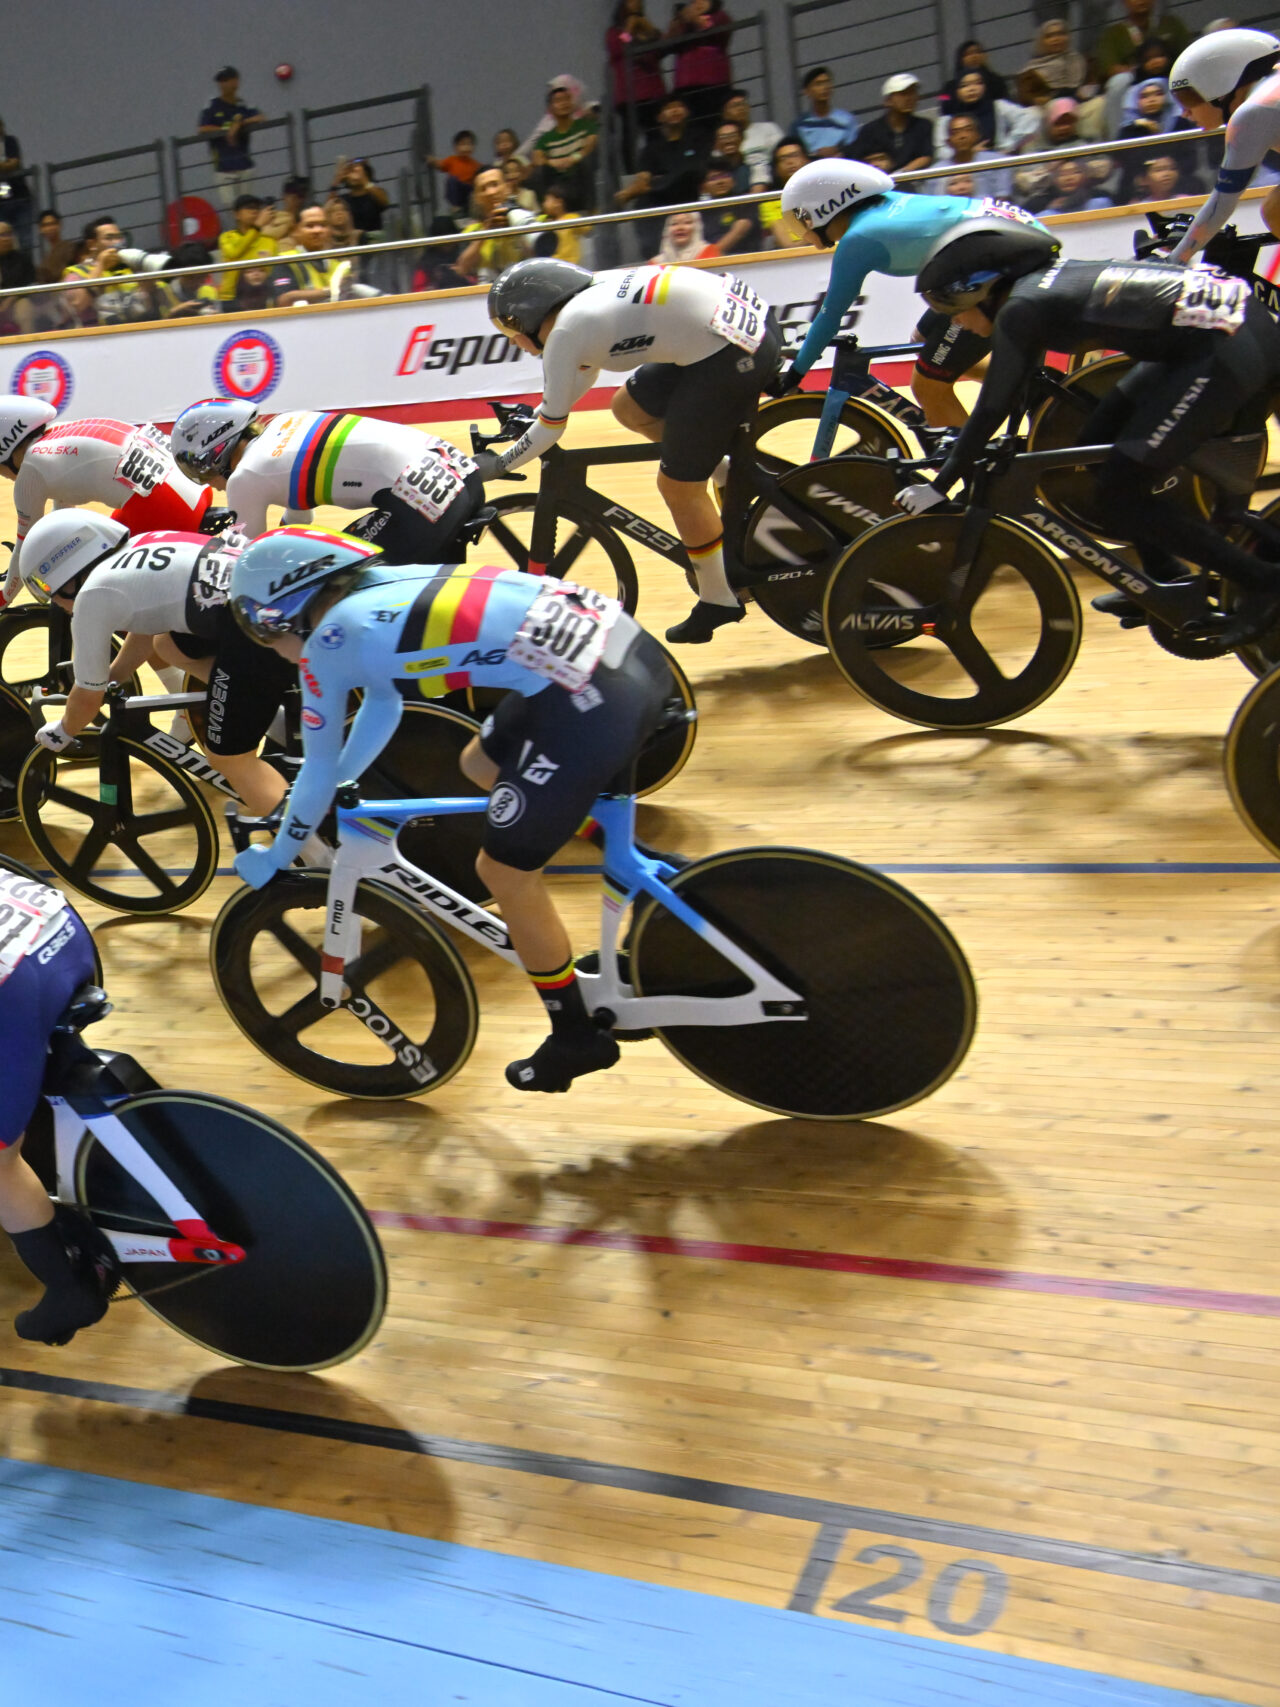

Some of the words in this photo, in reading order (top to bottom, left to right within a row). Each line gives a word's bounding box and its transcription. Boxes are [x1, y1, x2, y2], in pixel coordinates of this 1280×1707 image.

[722, 298, 758, 337] 318
[609, 334, 655, 352] KTM
[931, 343, 951, 365] HONG
[1147, 377, 1210, 448] MALAYSIA
[31, 445, 79, 457] POLSKA
[201, 420, 234, 448] LAZER
[407, 455, 457, 505] 333
[602, 506, 680, 551] FES
[1023, 512, 1121, 578] ARGON
[1119, 573, 1149, 595] 18
[269, 554, 337, 596] LAZER
[375, 610, 401, 623] EY
[531, 601, 599, 663] 307
[207, 668, 230, 745] EVIDEN
[522, 753, 560, 786] EY
[287, 815, 313, 842] EY
[331, 899, 345, 935] BEL
[124, 1247, 166, 1257] JAPAN
